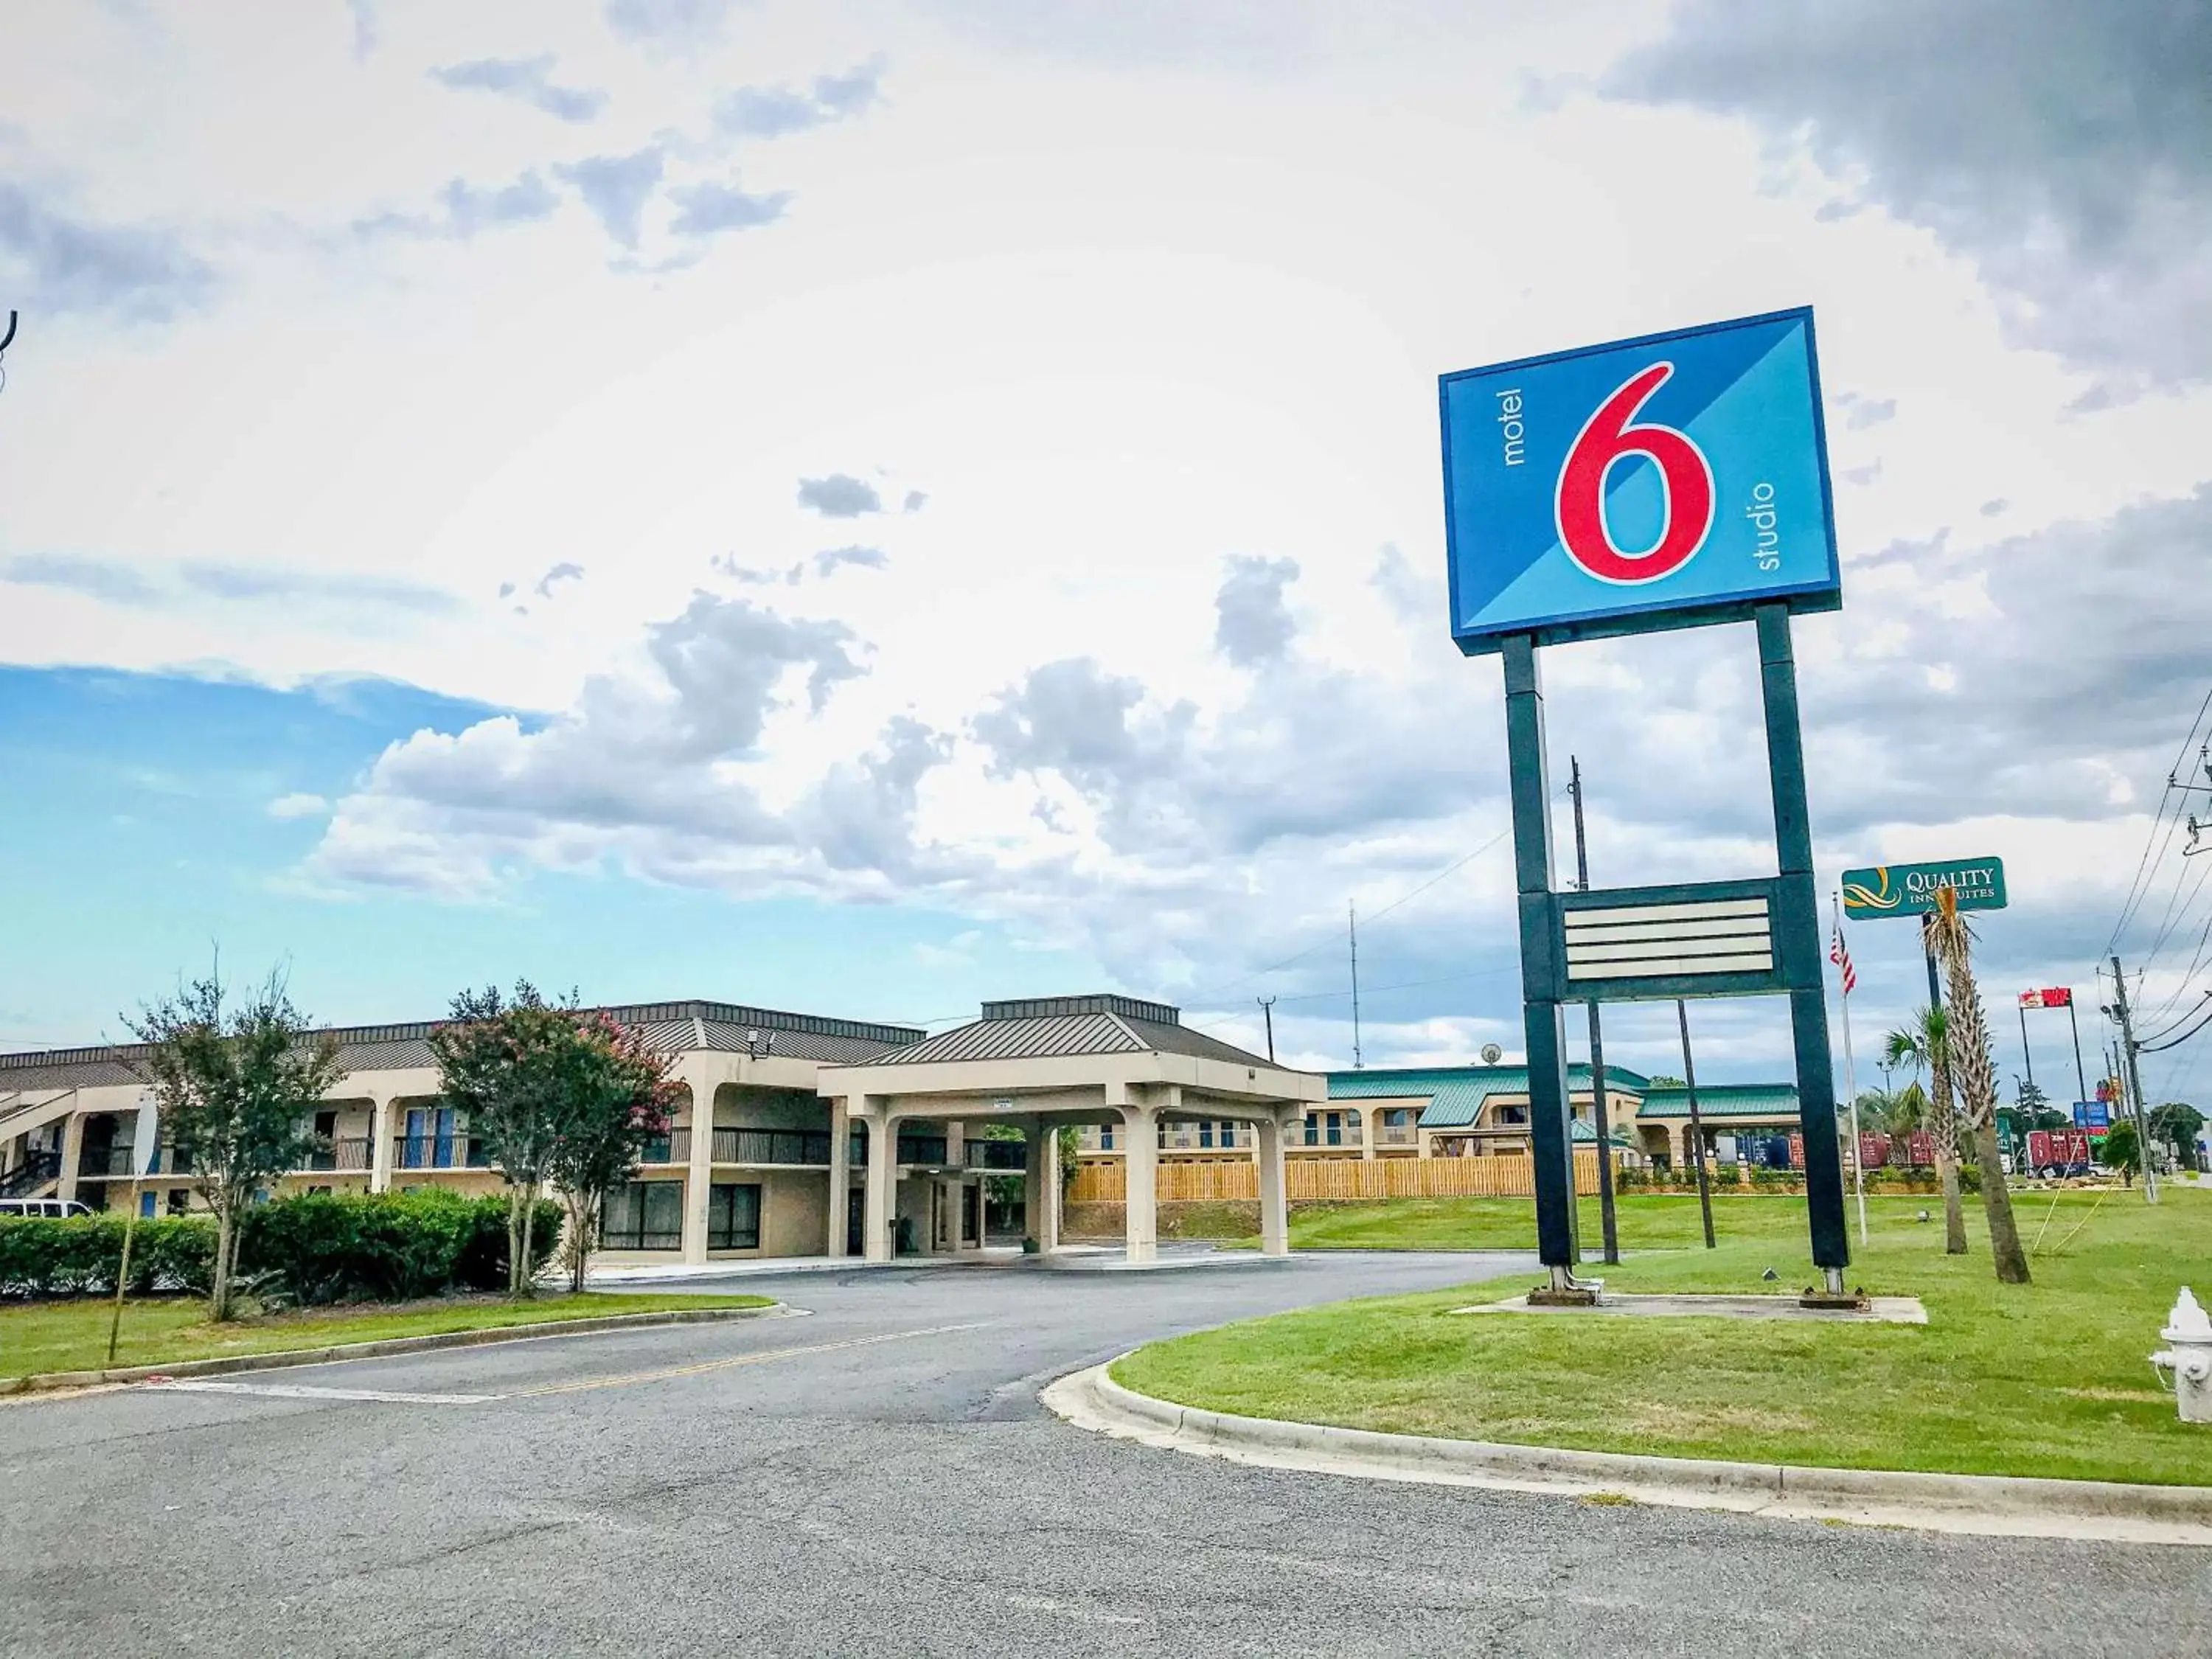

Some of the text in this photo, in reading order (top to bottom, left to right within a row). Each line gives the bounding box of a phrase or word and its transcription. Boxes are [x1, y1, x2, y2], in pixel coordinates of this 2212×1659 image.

[1496, 388, 1525, 467] motel
[1554, 361, 1717, 586] 6
[1745, 482, 1779, 571] studio
[1906, 868, 1994, 893] QUALITY
[1955, 888, 1994, 900] UITES
